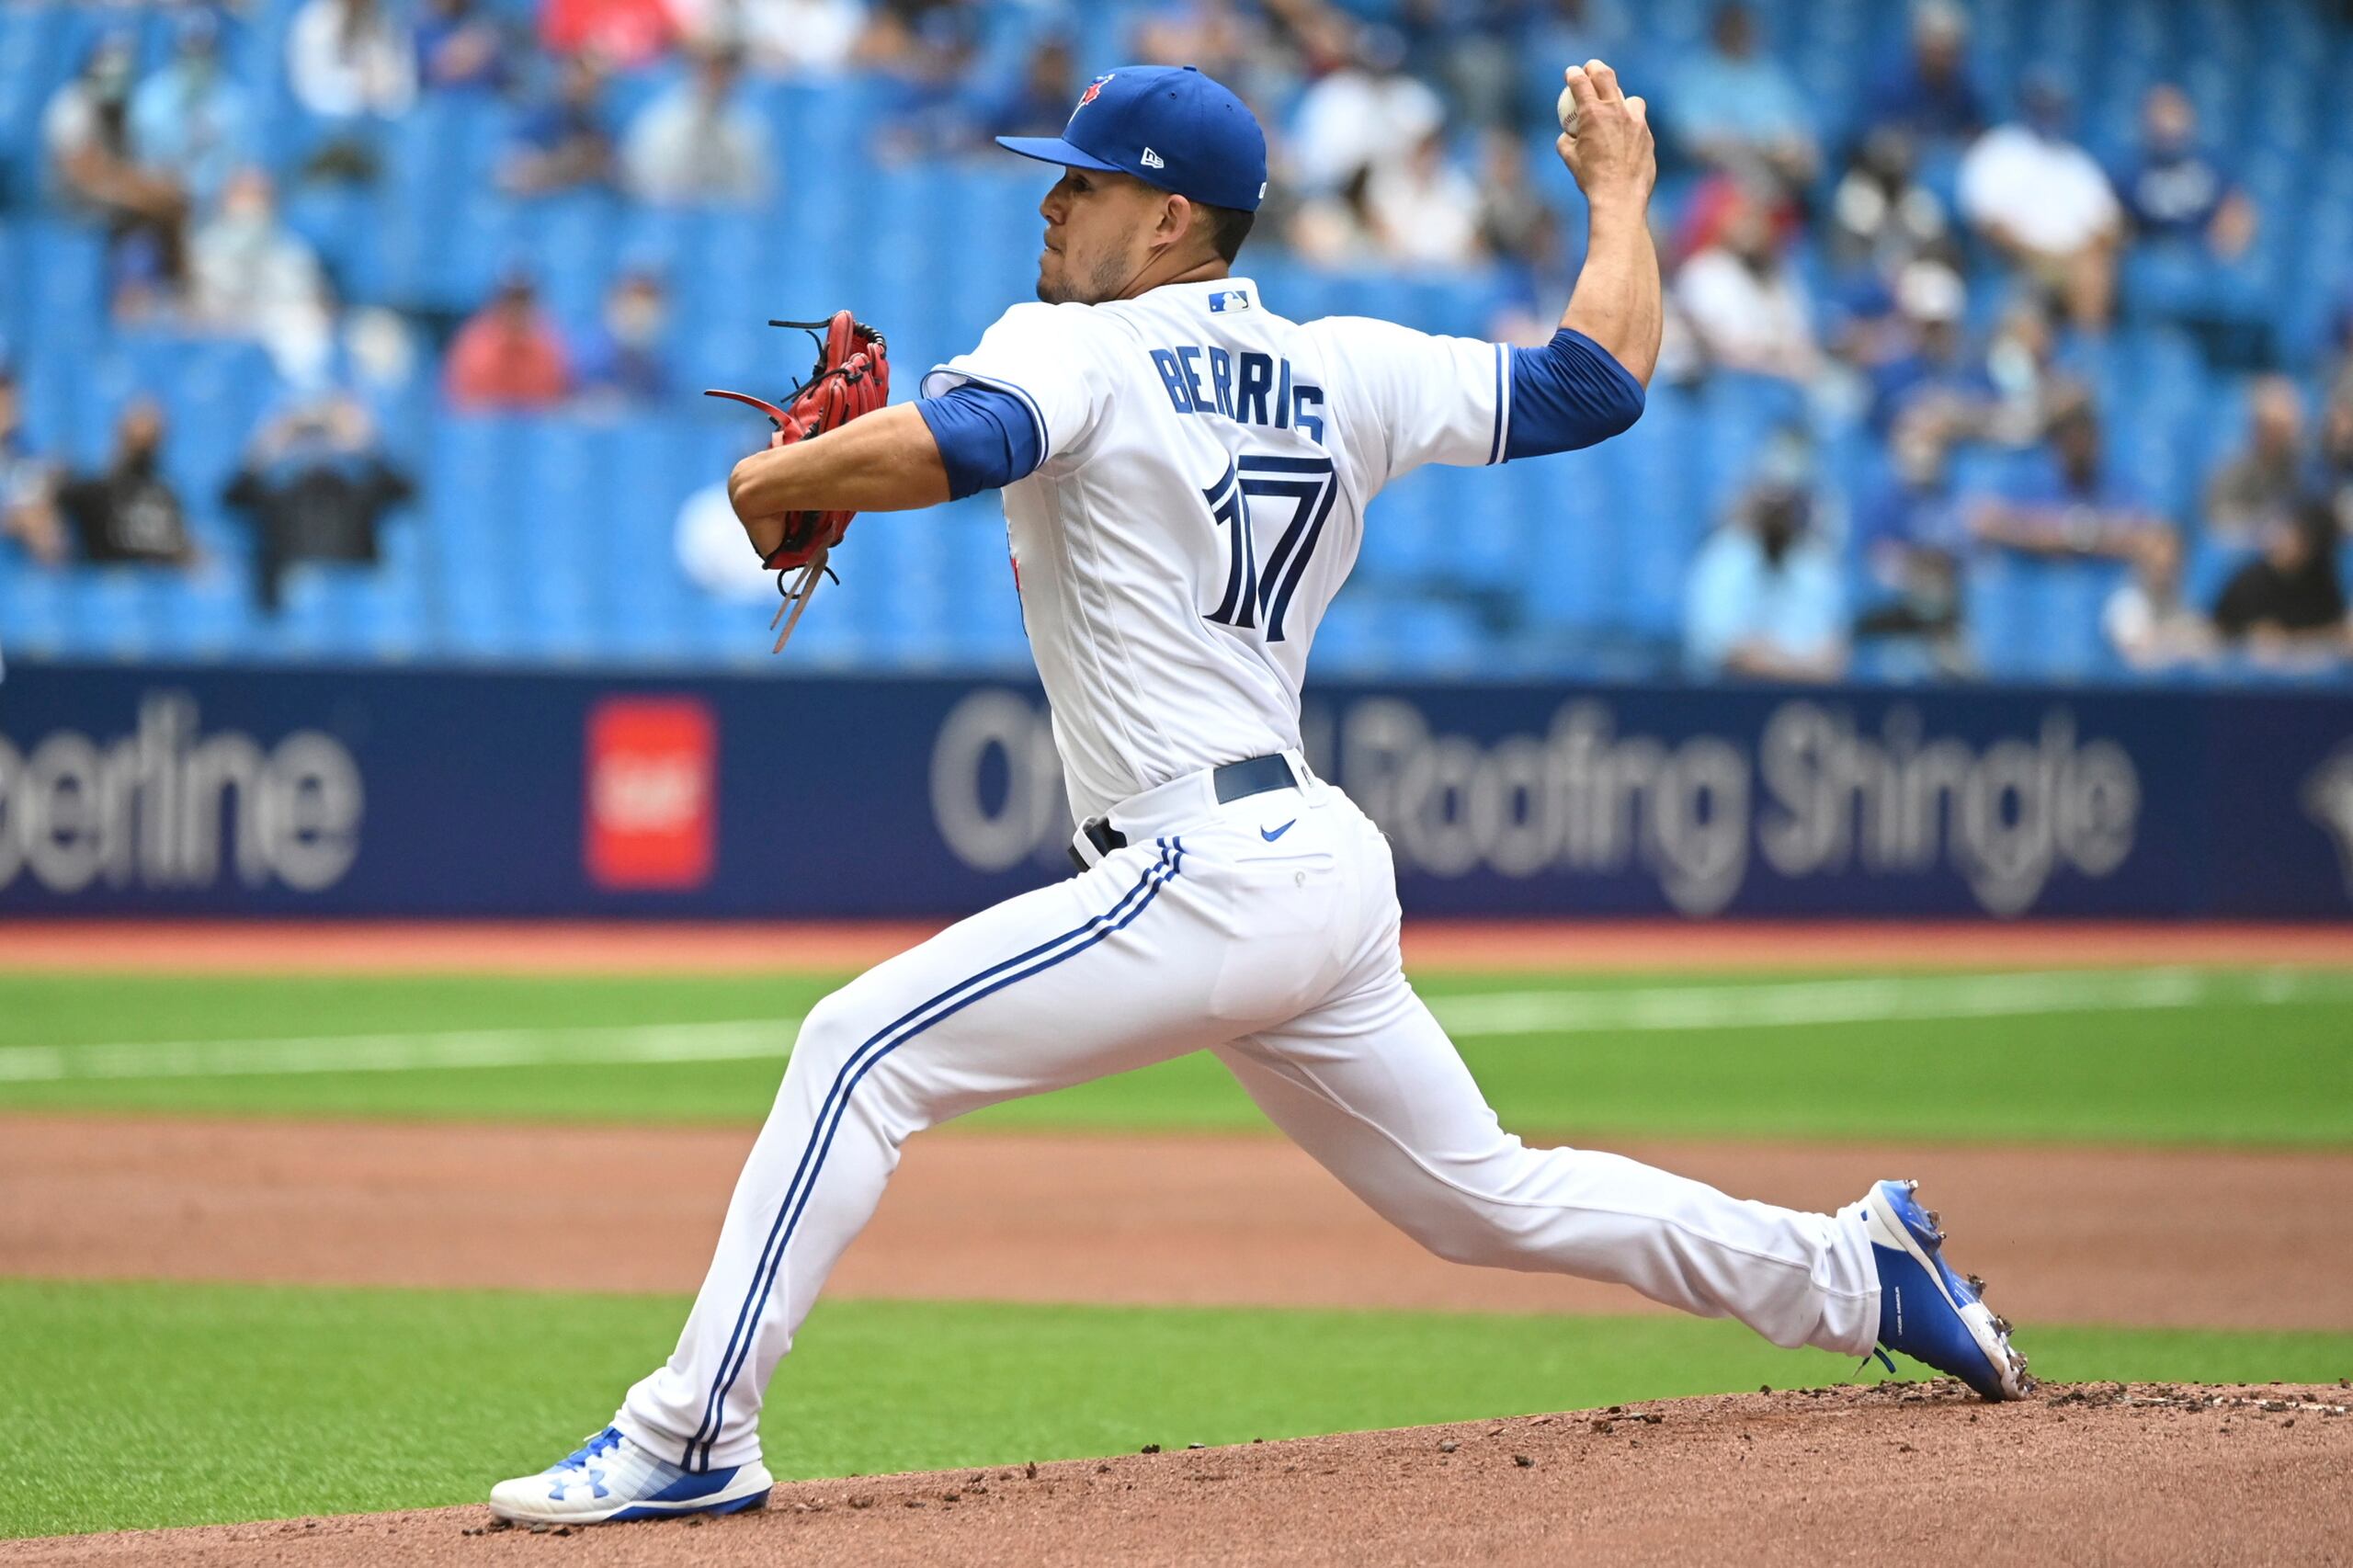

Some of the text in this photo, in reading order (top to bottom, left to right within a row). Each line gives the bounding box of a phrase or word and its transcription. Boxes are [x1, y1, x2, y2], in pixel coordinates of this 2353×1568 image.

[1201, 455, 1338, 642] 17
[1346, 696, 1748, 914] Roofing
[1756, 700, 2140, 914] Shingle
